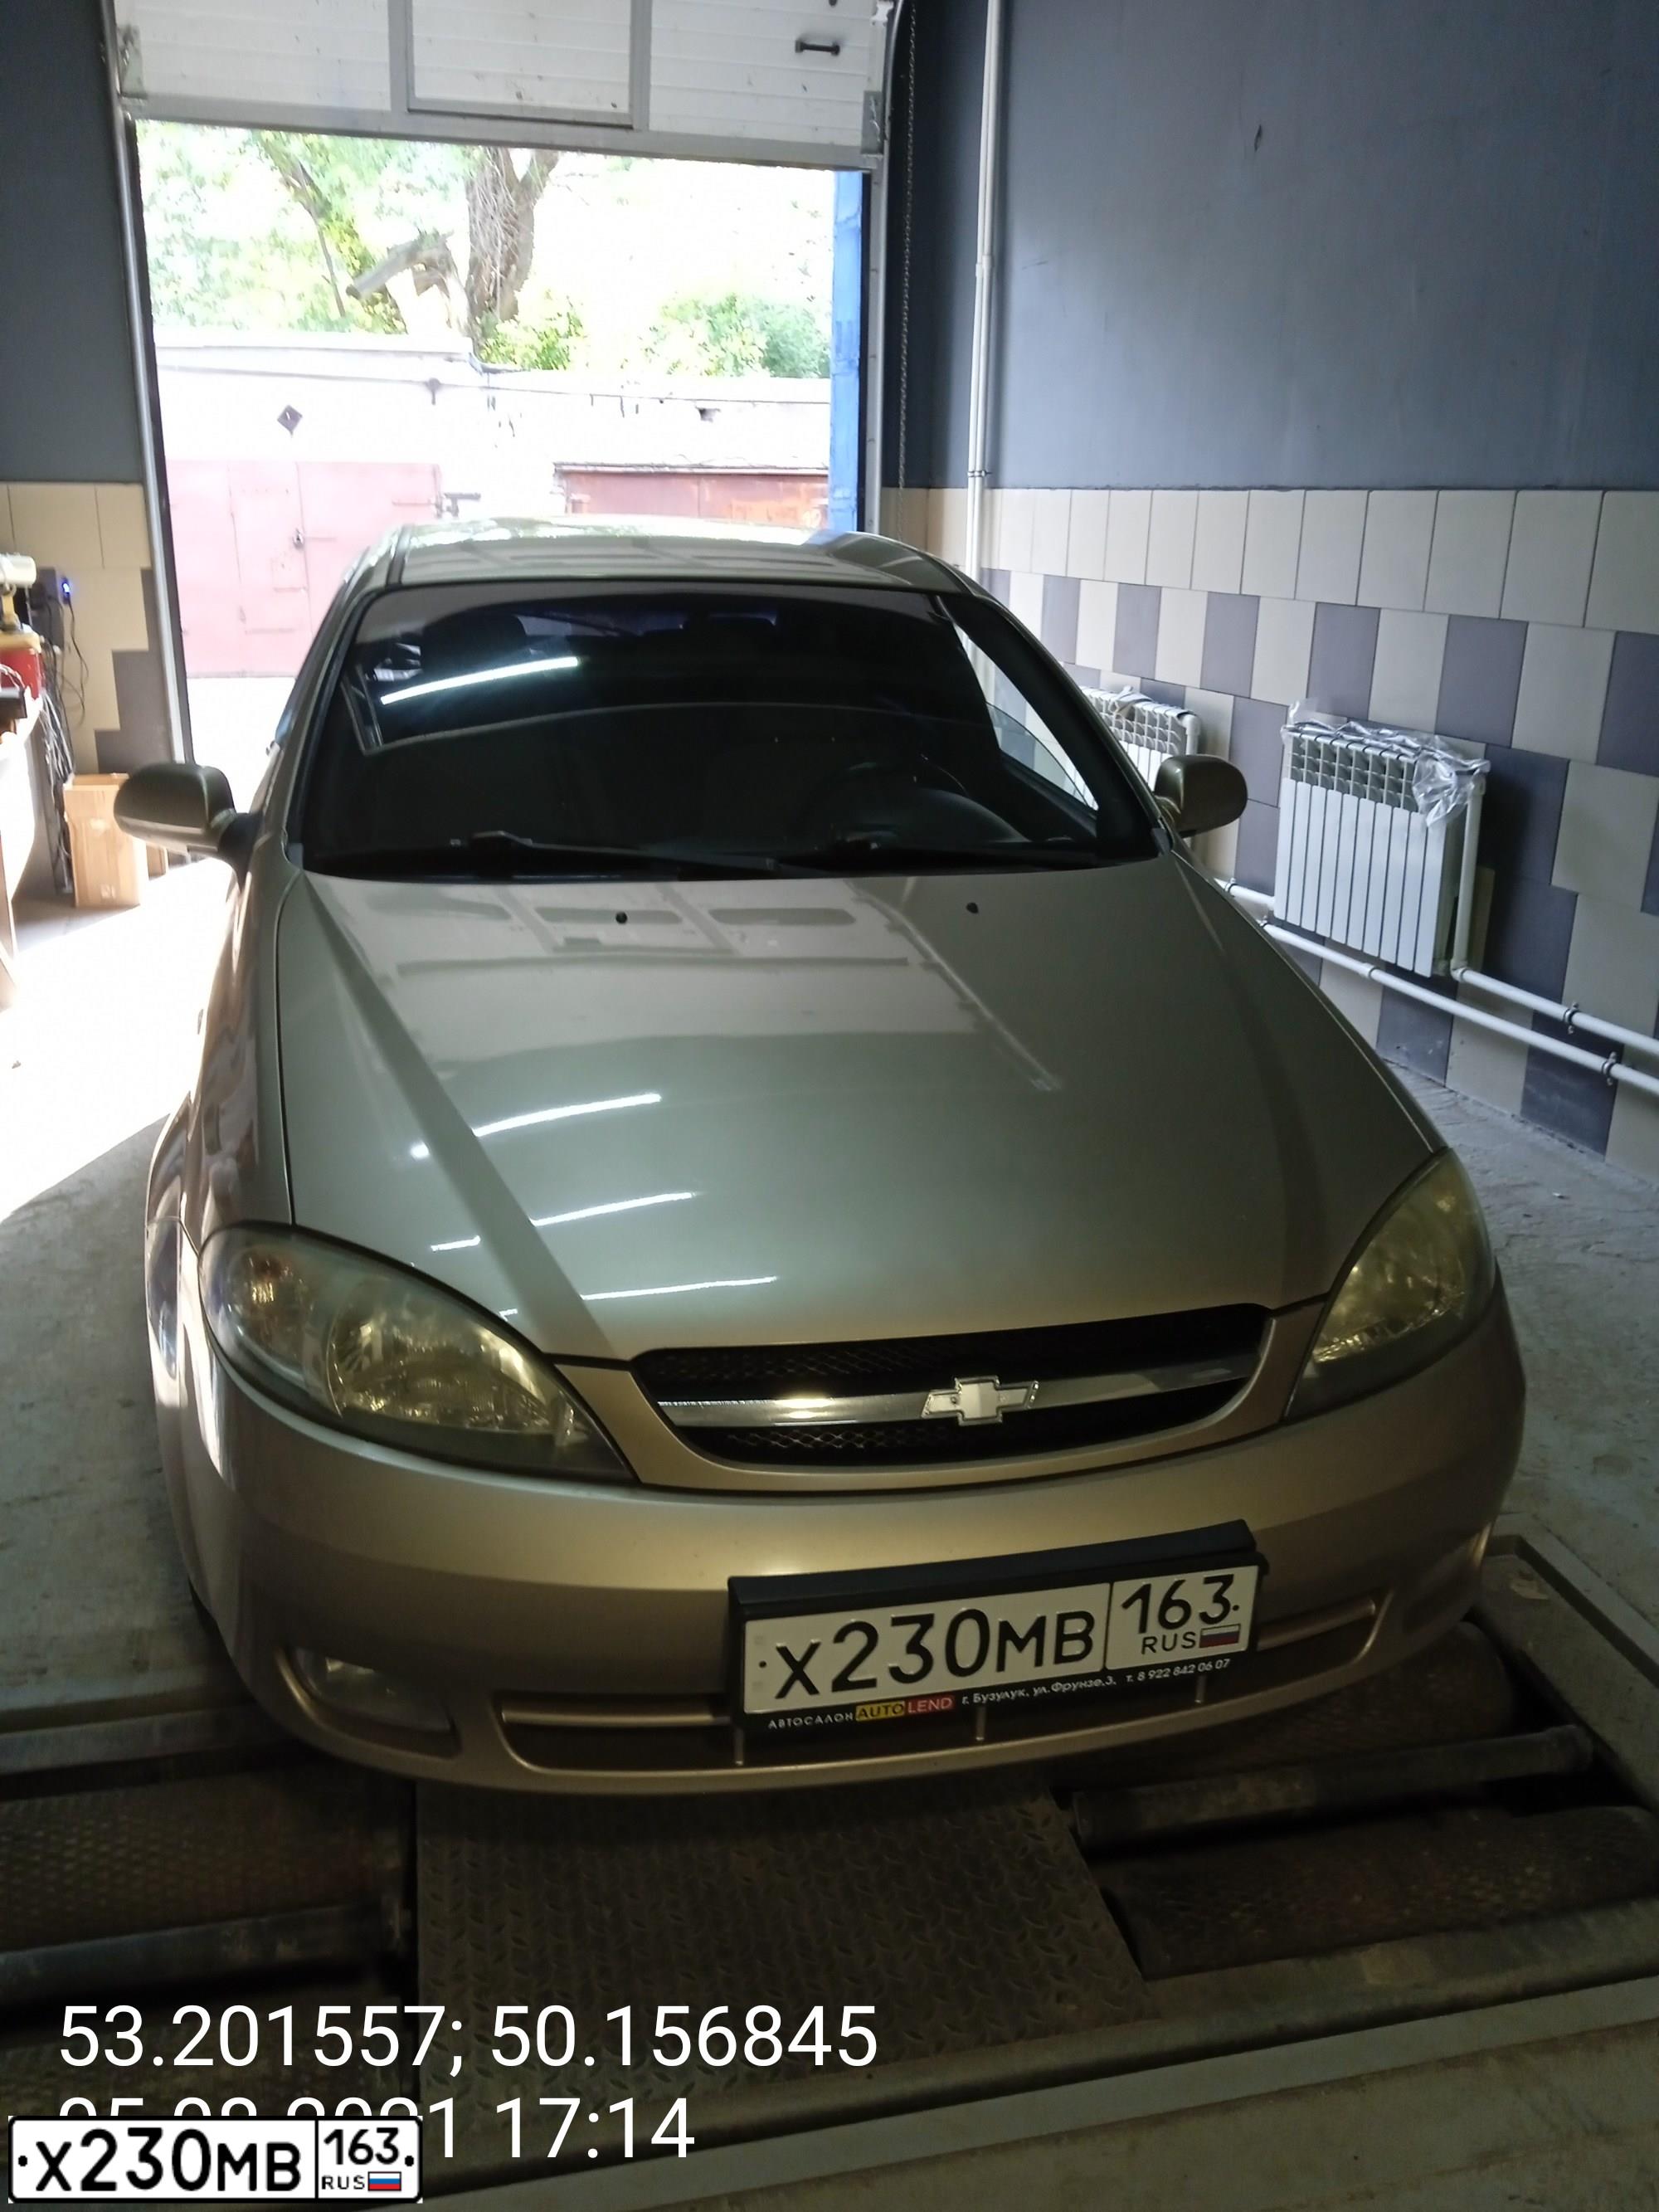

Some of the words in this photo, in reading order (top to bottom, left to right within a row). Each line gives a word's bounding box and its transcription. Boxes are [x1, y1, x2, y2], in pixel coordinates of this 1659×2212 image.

[775, 1608, 1096, 1699] Х230МВ
[1121, 1573, 1234, 1635] 163
[1141, 1631, 1196, 1654] RUS
[768, 1712, 854, 1729] АВТОСАЛОН
[1136, 1671, 1146, 1682] 8
[1147, 1667, 1170, 1680] 922
